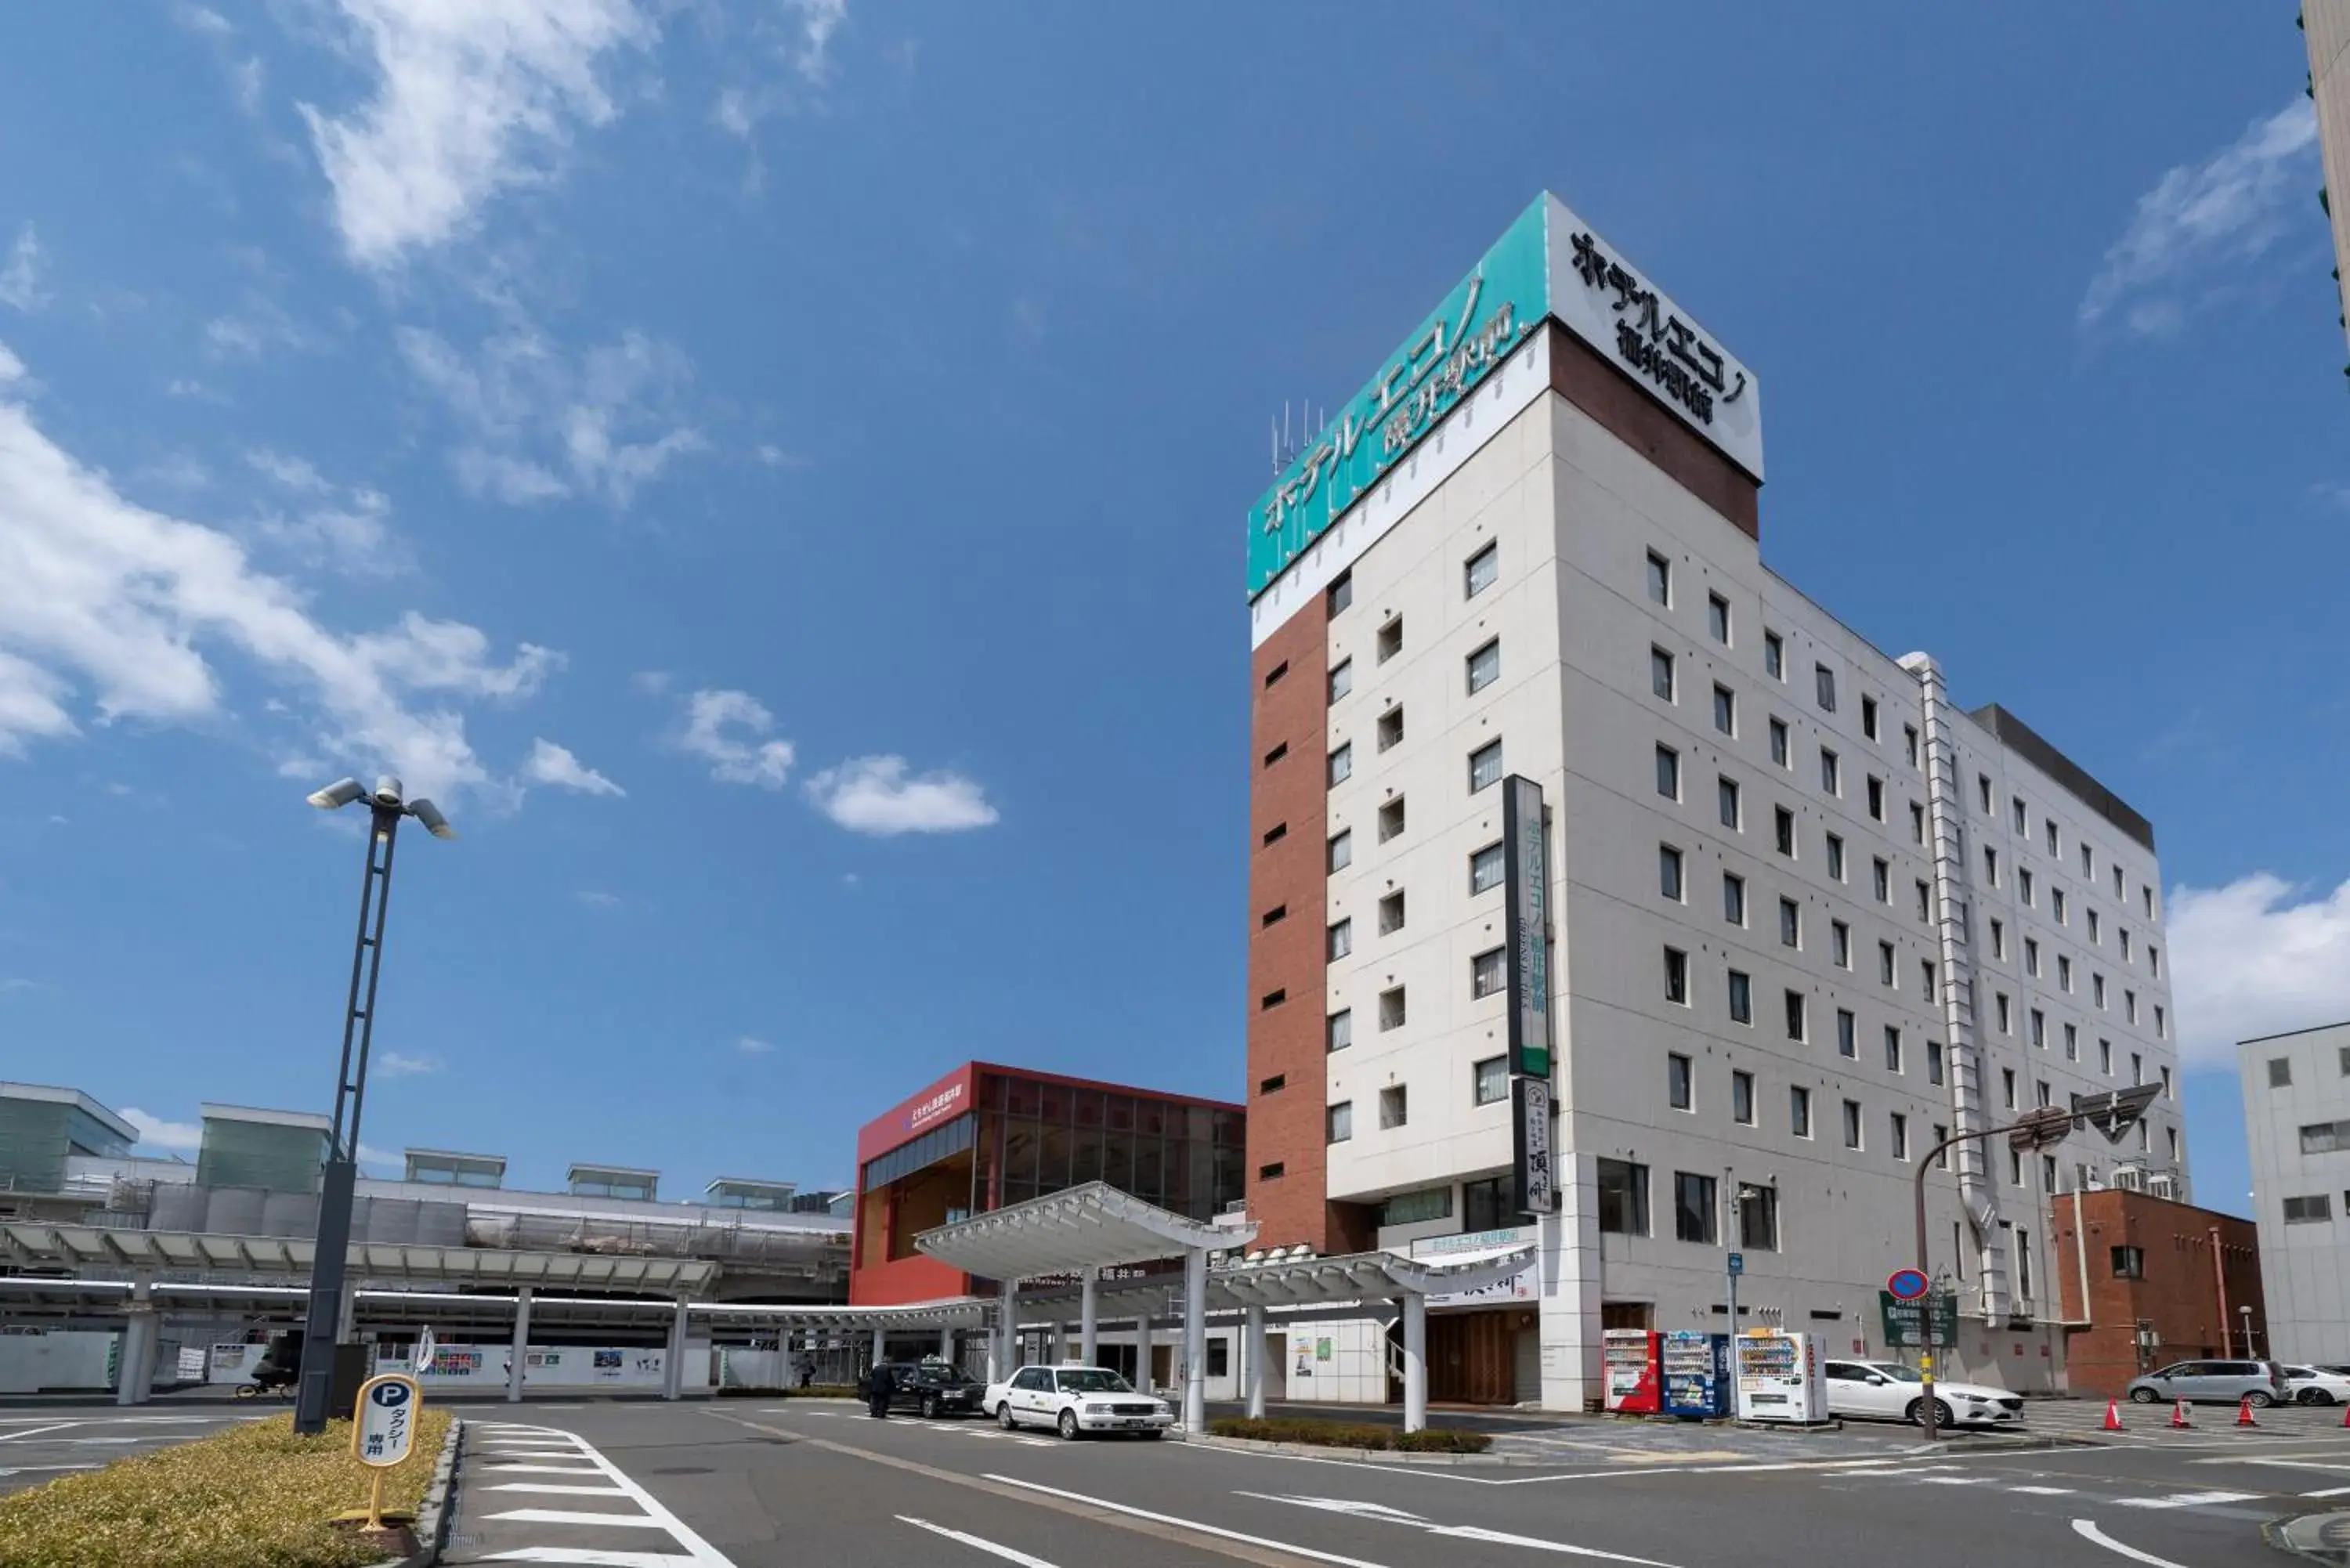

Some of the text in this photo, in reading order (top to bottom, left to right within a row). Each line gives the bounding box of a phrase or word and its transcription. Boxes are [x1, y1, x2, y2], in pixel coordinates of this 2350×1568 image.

[1571, 232, 1746, 403] ホテルエコノ
[1616, 317, 1713, 426] 福井駅前
[1264, 277, 1484, 529] ホテルエコノ
[1383, 301, 1516, 456] 福井駅前
[367, 1433, 384, 1455] 専用
[381, 1386, 402, 1404] P
[388, 1408, 407, 1449] タクシー
